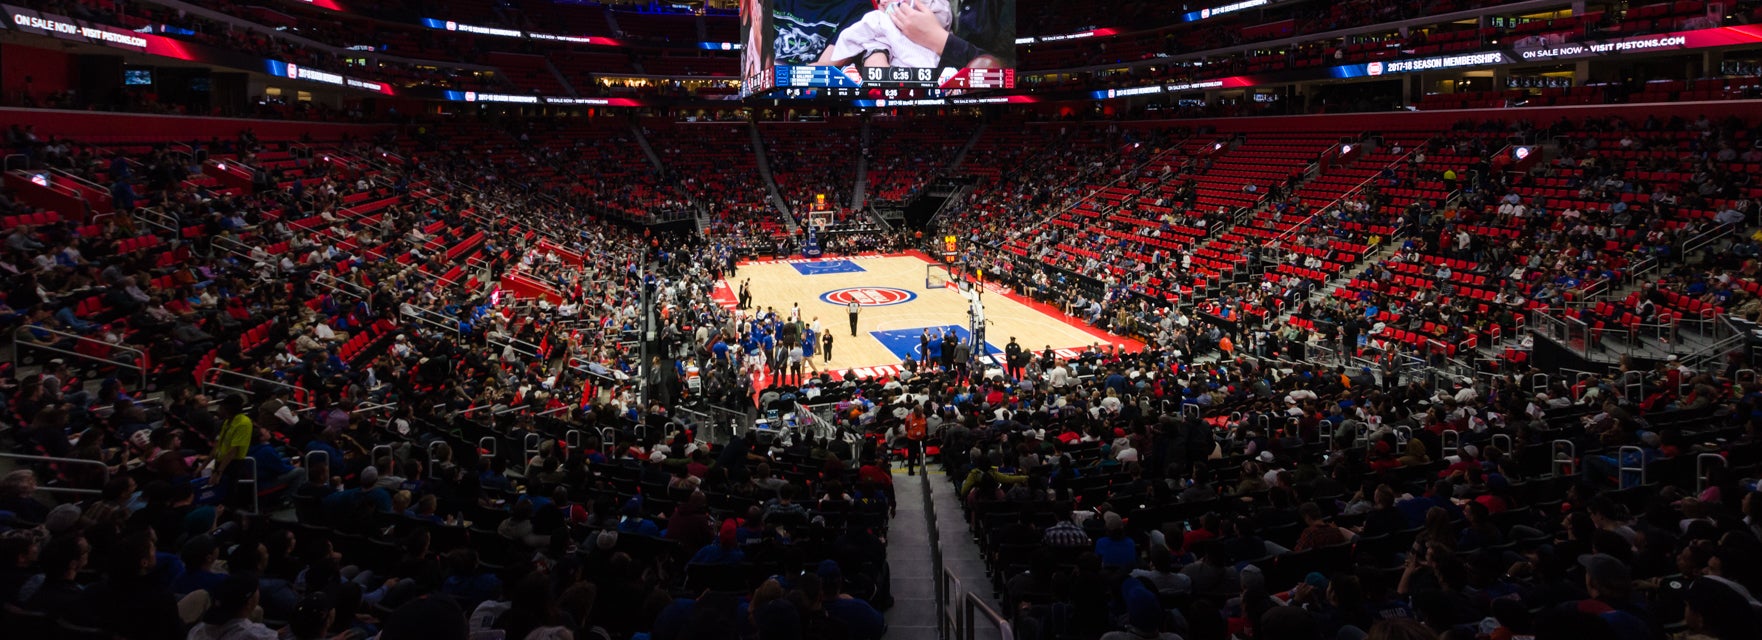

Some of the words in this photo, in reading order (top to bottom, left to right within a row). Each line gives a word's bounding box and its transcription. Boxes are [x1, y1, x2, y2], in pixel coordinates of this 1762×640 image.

[14, 14, 30, 26] ON
[31, 17, 54, 31] SALE
[55, 21, 76, 35] NOW
[81, 27, 101, 38] VISIT
[102, 31, 147, 48] PISTONS.COM
[1537, 49, 1558, 57] SALE
[1560, 46, 1582, 55] NOW
[1590, 43, 1614, 52] VISIT
[1616, 36, 1686, 50] PISTONS.COM
[1388, 62, 1412, 72] 2017-18
[1413, 58, 1442, 69] SEASON
[1443, 52, 1502, 67] MEMBERSHIPS
[868, 67, 882, 80] 50
[893, 71, 909, 80] 6:35
[918, 68, 932, 81] 63
